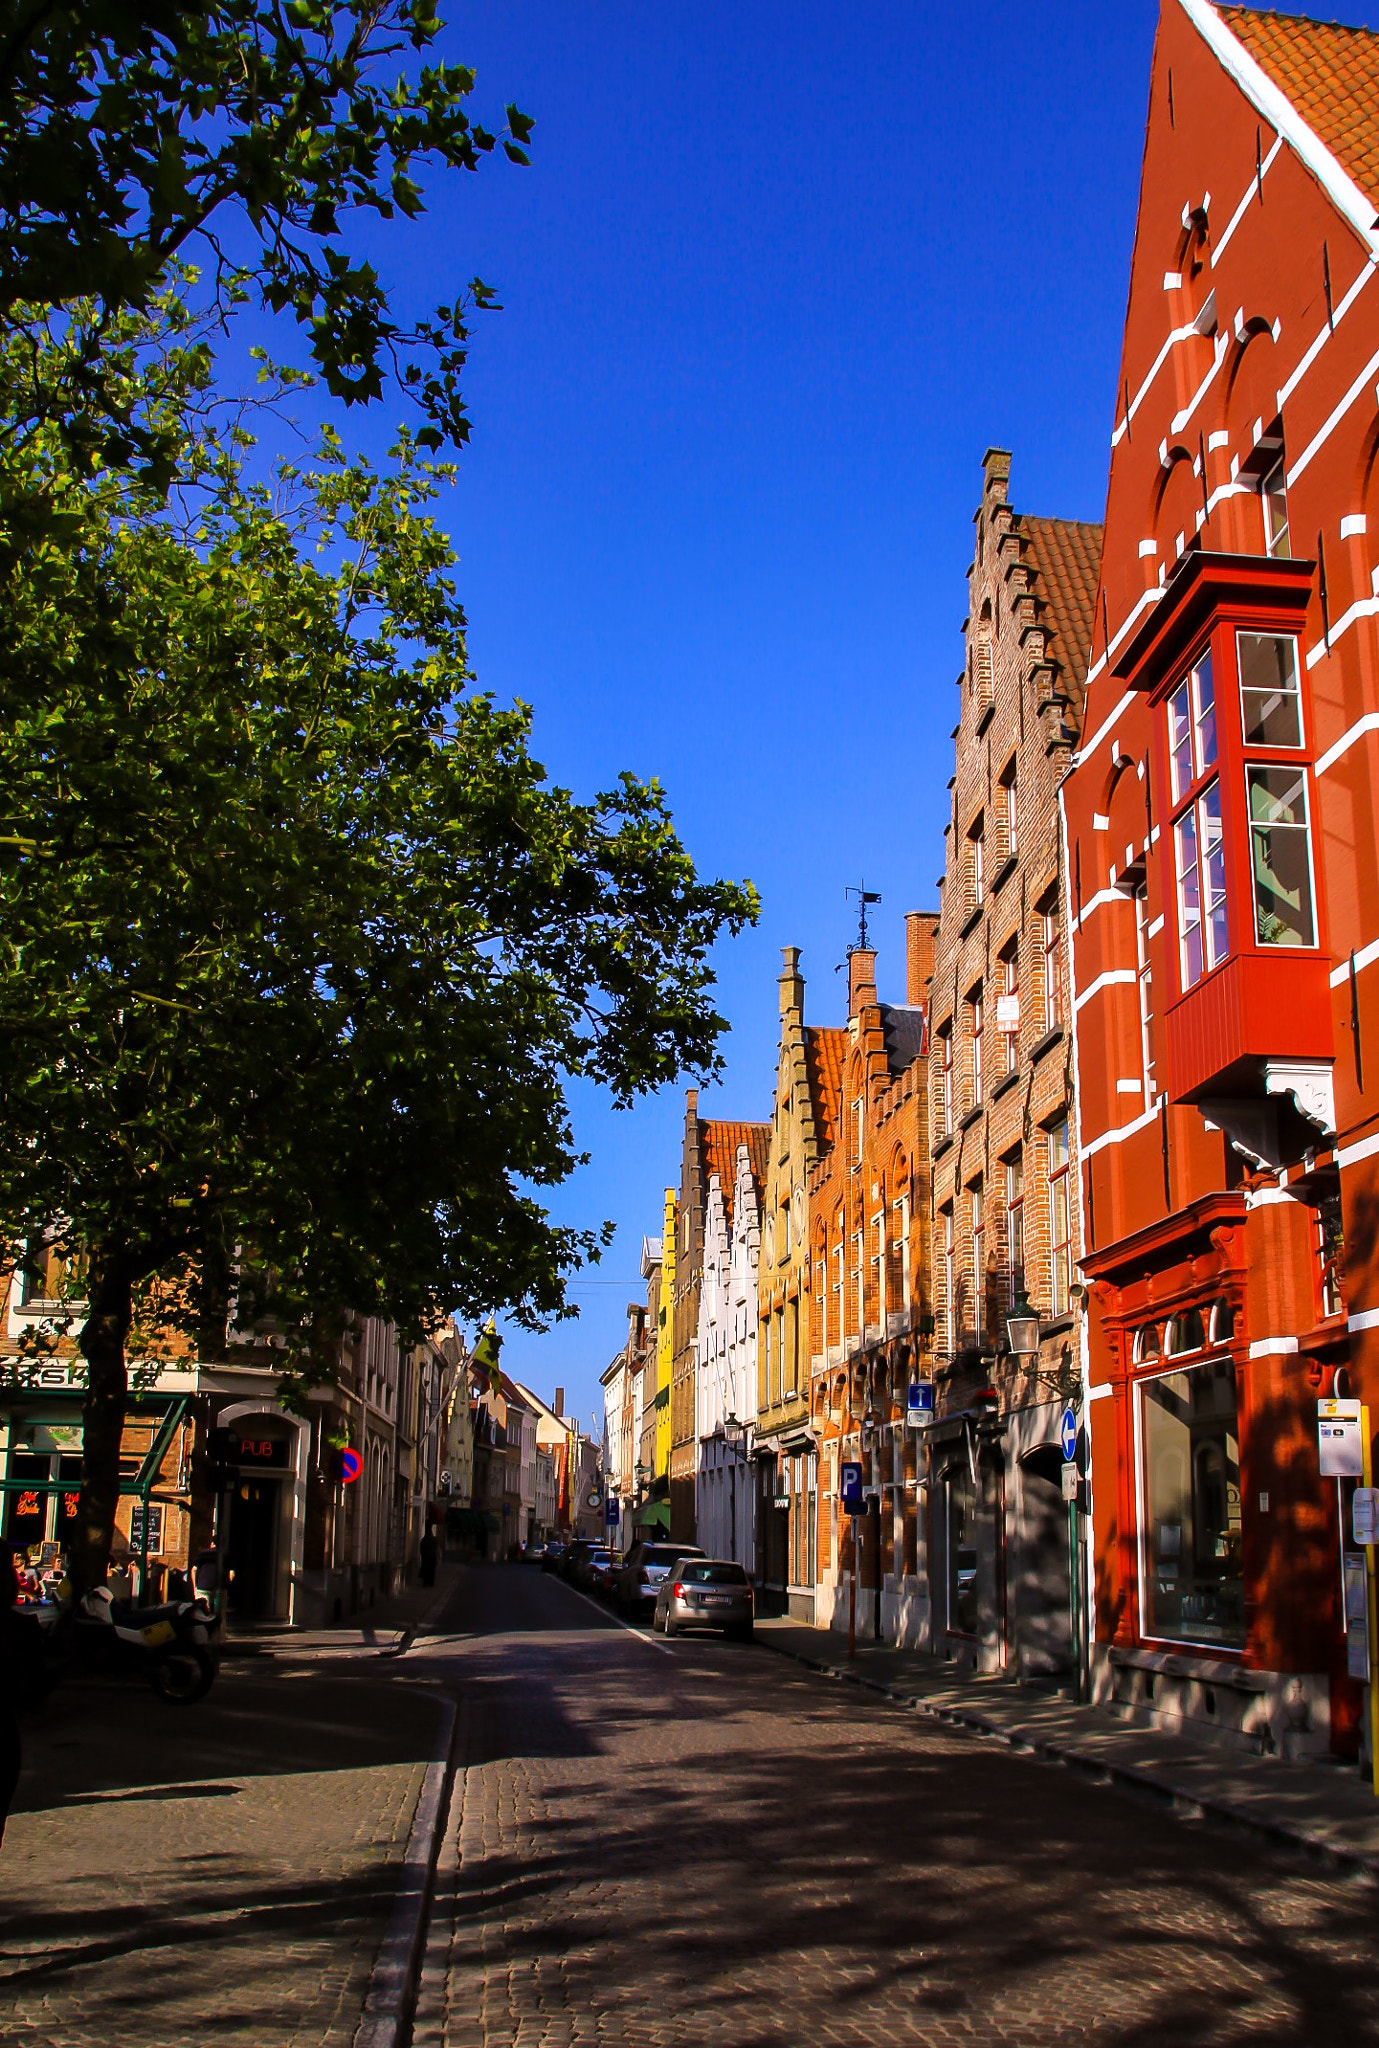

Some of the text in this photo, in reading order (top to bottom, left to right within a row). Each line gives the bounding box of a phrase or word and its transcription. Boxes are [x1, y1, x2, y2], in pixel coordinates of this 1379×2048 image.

[241, 1440, 273, 1457] PUB
[842, 1468, 858, 1496] P
[609, 1499, 617, 1510] P
